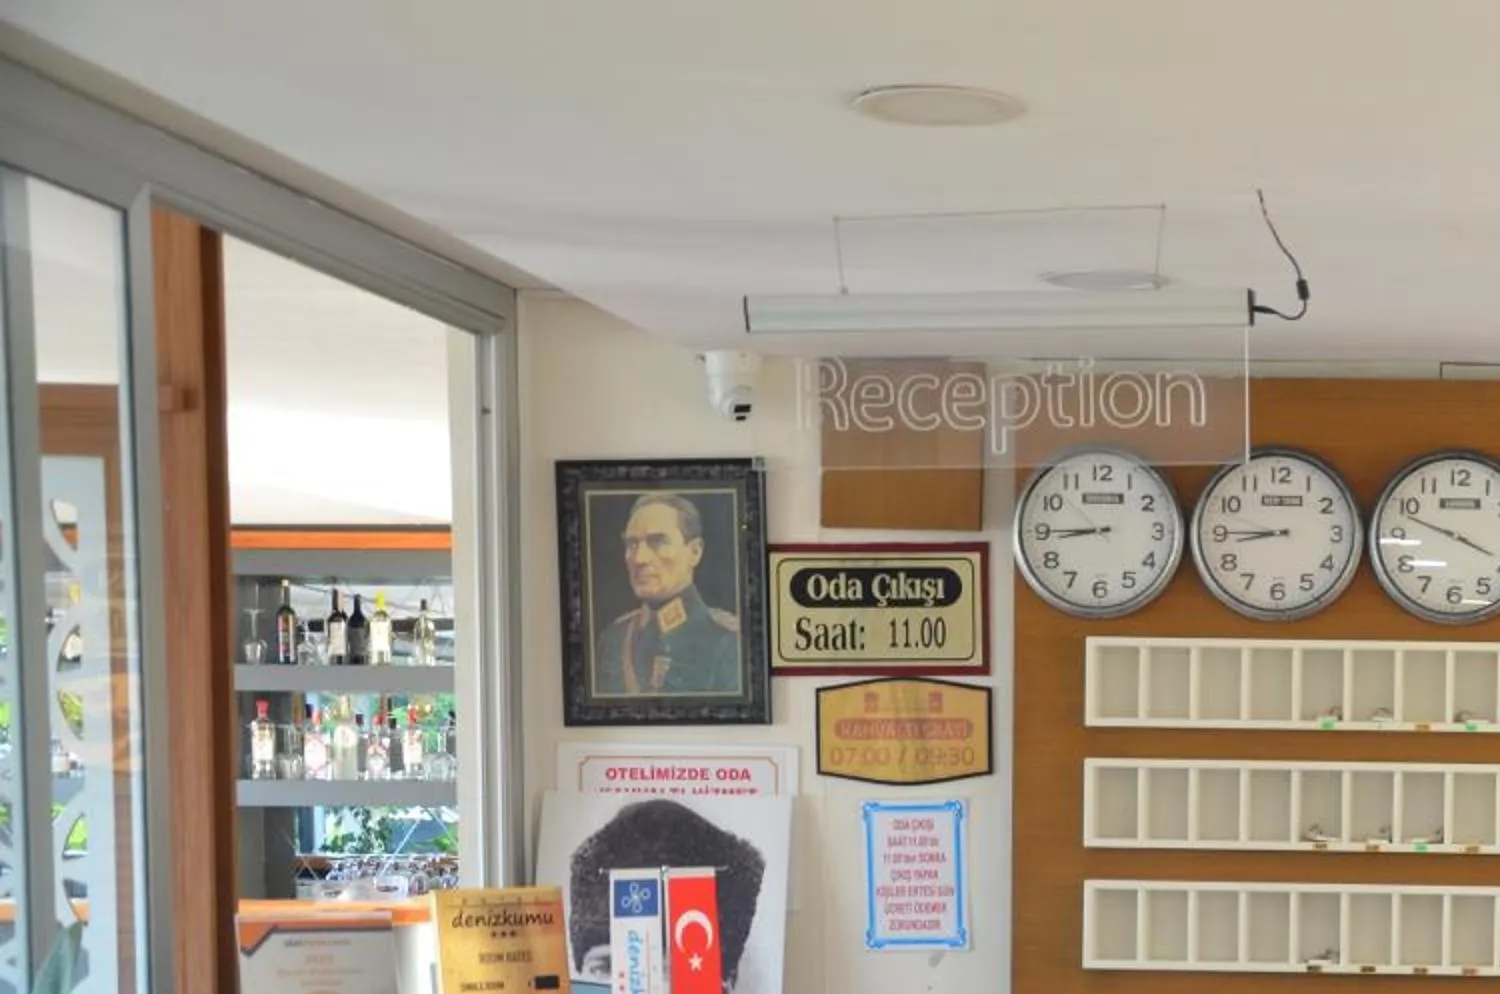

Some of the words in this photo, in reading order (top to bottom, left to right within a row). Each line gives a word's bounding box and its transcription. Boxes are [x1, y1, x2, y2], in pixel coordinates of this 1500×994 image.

[802, 355, 1207, 455] Reception
[1063, 473, 1079, 490] 11
[1092, 464, 1113, 482] 12
[1127, 473, 1132, 490] 1
[1270, 467, 1291, 484] 12
[1451, 469, 1471, 487] 12
[1242, 475, 1257, 493] 11
[1306, 475, 1311, 492] 1
[1421, 477, 1437, 494] 11
[1486, 479, 1490, 496] 1
[1043, 493, 1063, 511] 10
[1140, 494, 1155, 512] 2
[1221, 495, 1241, 513] 10
[1319, 497, 1334, 514] 2
[1400, 497, 1420, 515] 10
[1034, 523, 1050, 541] 9
[1151, 521, 1164, 541] 3
[1213, 525, 1228, 543] 9
[1330, 525, 1343, 543] 3
[1043, 551, 1060, 569] 8
[1141, 551, 1156, 569] 4
[1220, 553, 1238, 571] 8
[1320, 554, 1334, 571] 4
[1397, 555, 1415, 573] 8
[1063, 571, 1078, 588] 7
[1121, 571, 1137, 588] 5
[1240, 573, 1256, 590] 7
[1299, 573, 1314, 591] 5
[1417, 575, 1432, 593] 7
[1476, 577, 1491, 595] 5
[806, 572, 863, 601] Oda
[871, 571, 946, 607] Çıkışı
[1091, 581, 1108, 598] 6
[1270, 583, 1286, 601] 6
[1446, 586, 1463, 604] 6
[795, 616, 866, 651] Saat:
[889, 616, 947, 649] 11.00
[605, 764, 710, 781] OTELİMİZDE
[715, 767, 751, 781] ODA
[451, 906, 555, 929] denizkumu
